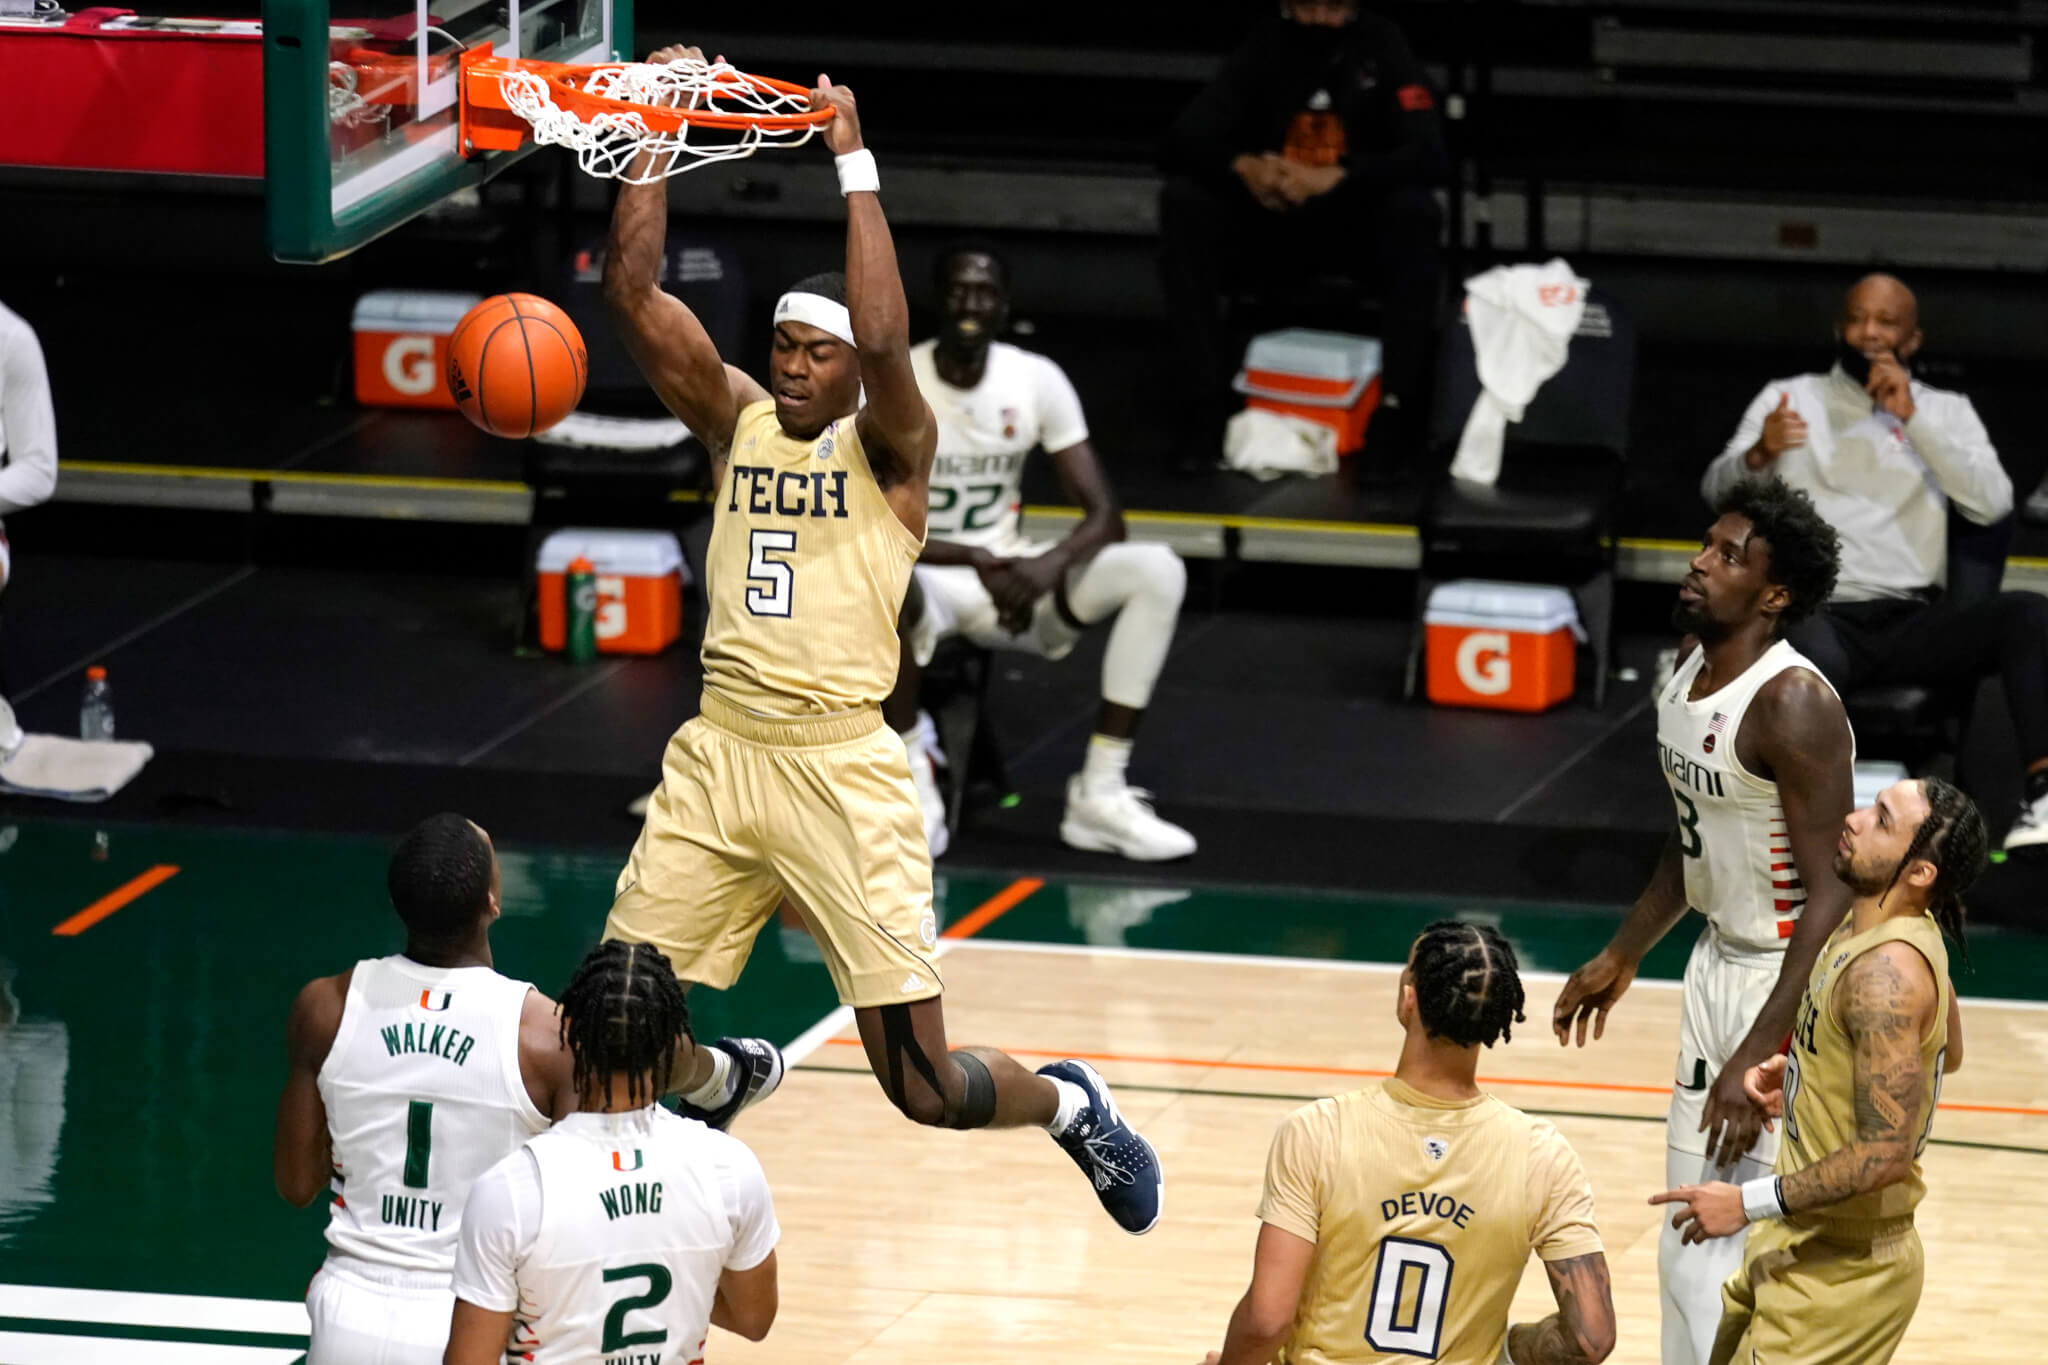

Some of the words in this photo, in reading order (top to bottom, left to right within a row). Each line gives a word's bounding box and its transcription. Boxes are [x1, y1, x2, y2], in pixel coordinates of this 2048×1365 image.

[384, 336, 436, 395] G
[728, 466, 849, 518] TECH
[928, 485, 1004, 531] 22
[745, 529, 797, 618] 5
[1456, 631, 1511, 695] G
[1675, 787, 1702, 859] 3
[380, 1022, 475, 1066] WALKER
[403, 1100, 433, 1189] 1
[381, 1194, 442, 1232] UNITY
[600, 1182, 662, 1221] WONG
[1380, 1191, 1475, 1230] DEVOE
[601, 1263, 672, 1354] 2
[1364, 1235, 1455, 1360] 0
